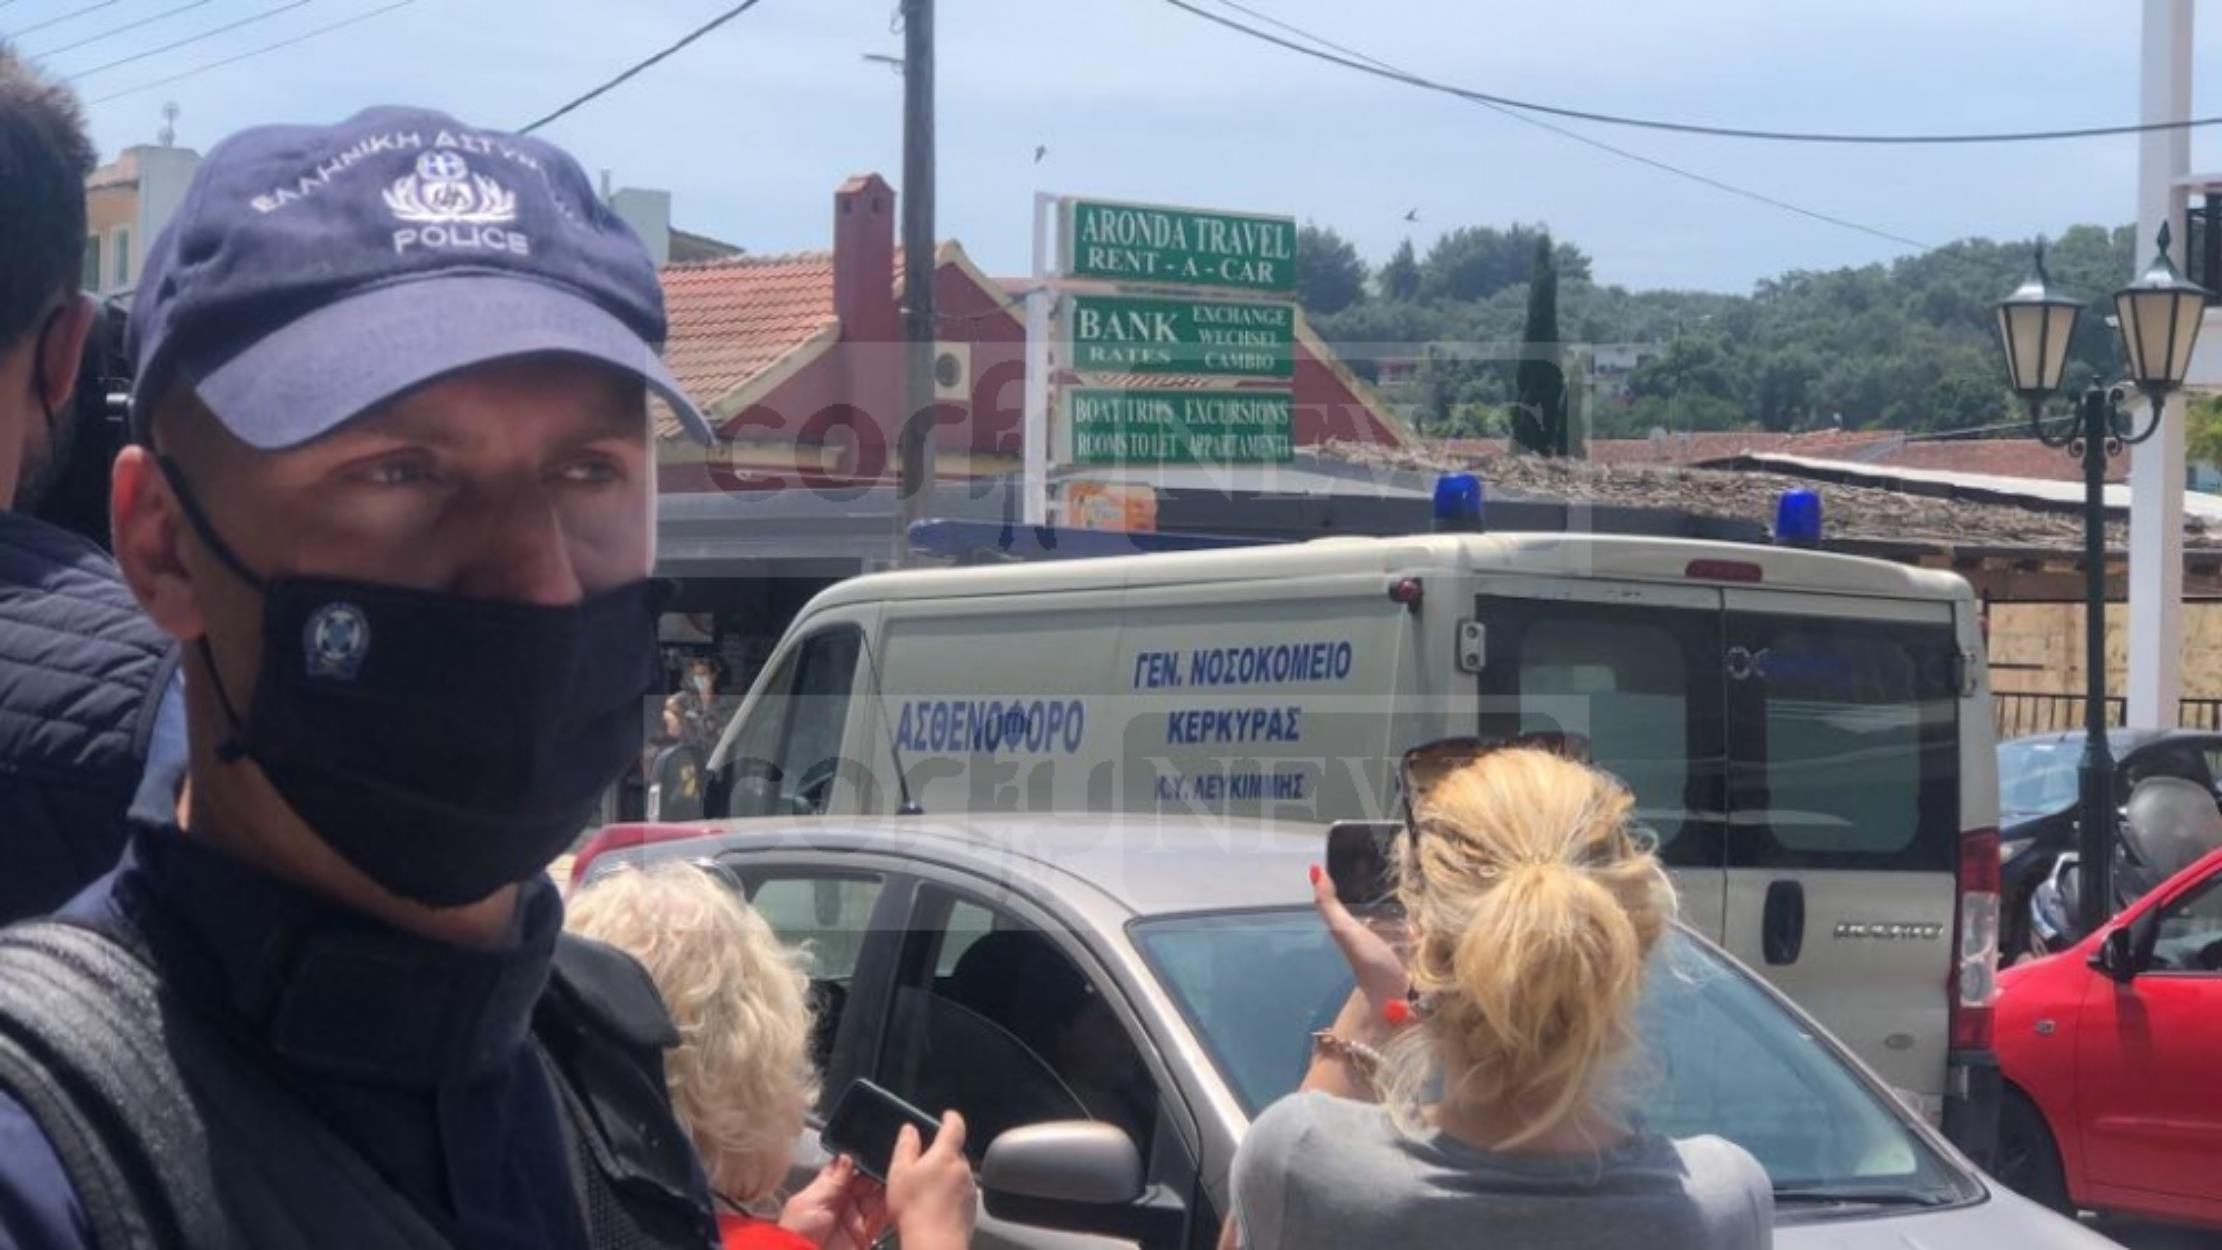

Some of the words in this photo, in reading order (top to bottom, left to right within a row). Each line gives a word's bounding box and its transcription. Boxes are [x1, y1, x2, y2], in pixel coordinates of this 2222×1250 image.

[393, 226, 530, 255] POLICE
[1082, 210, 1187, 251] ARONDA
[1193, 217, 1291, 259] TRAVEL
[1087, 249, 1159, 273] RENT
[1181, 256, 1199, 277] A
[1220, 258, 1275, 283] CAR
[1079, 307, 1181, 344] BANK
[1193, 305, 1287, 327] EXCHANGE
[1199, 328, 1281, 349] WECHSEL
[1090, 346, 1171, 363] RATES
[1204, 353, 1275, 370] CAMBIO
[1076, 399, 1121, 423] BOAT
[1126, 399, 1173, 423] TRIPS
[1185, 399, 1288, 425] EXCURSIONS
[1078, 433, 1128, 457] ROOMS
[1131, 434, 1148, 456] TO
[1151, 434, 1177, 456] LET
[1134, 650, 1183, 688] ΓΕΝ.
[1190, 641, 1353, 686] ΝΟΣΟΚΟΜΕΙΟ
[897, 699, 1085, 755] ΑΣΘΕΝΟΦΟΡΟ
[1167, 707, 1301, 744] ΚΕΡΚΥΡΑΣ
